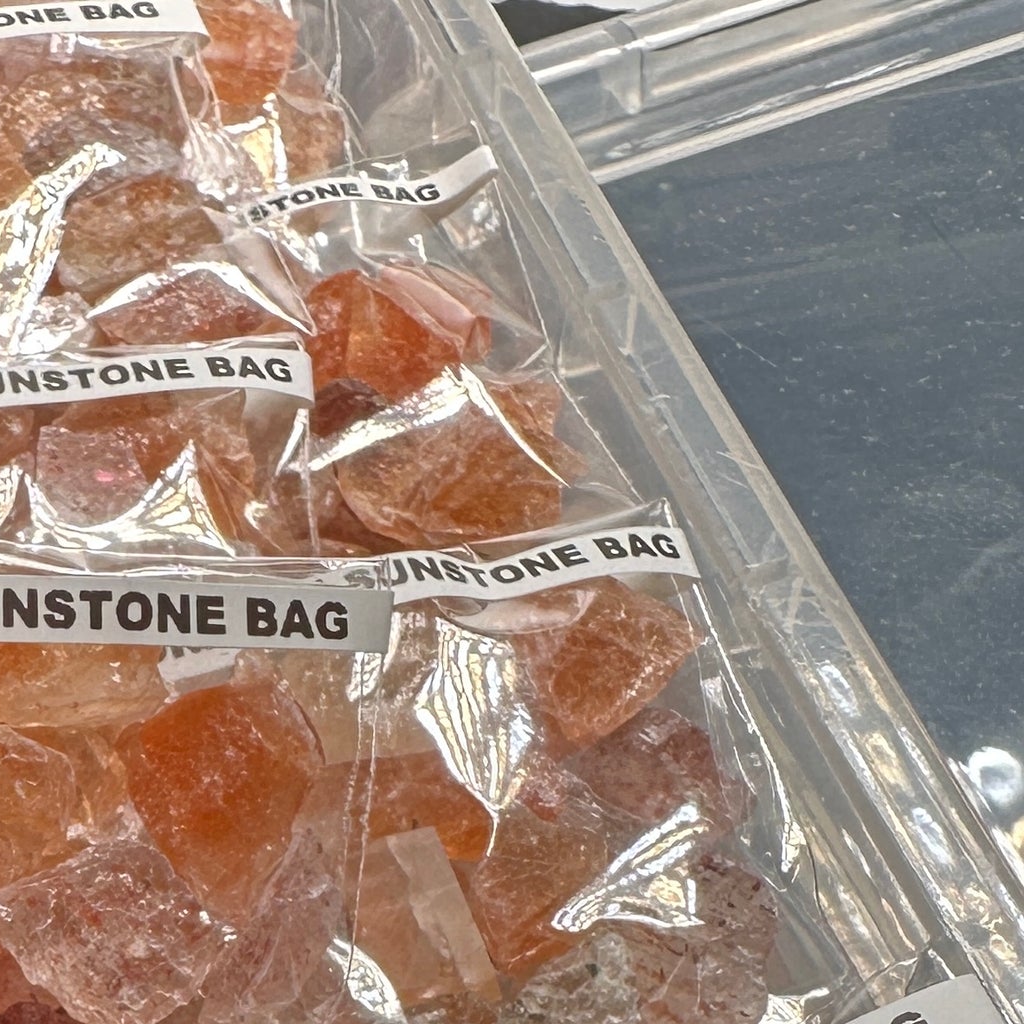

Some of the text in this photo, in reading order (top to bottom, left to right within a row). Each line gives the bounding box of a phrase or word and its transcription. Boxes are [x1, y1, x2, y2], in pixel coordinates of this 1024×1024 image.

[79, 1, 160, 20] BAG
[370, 183, 440, 203] BAG
[204, 355, 292, 382] BAG
[592, 533, 681, 559] BAG
[246, 597, 348, 640] BAG
